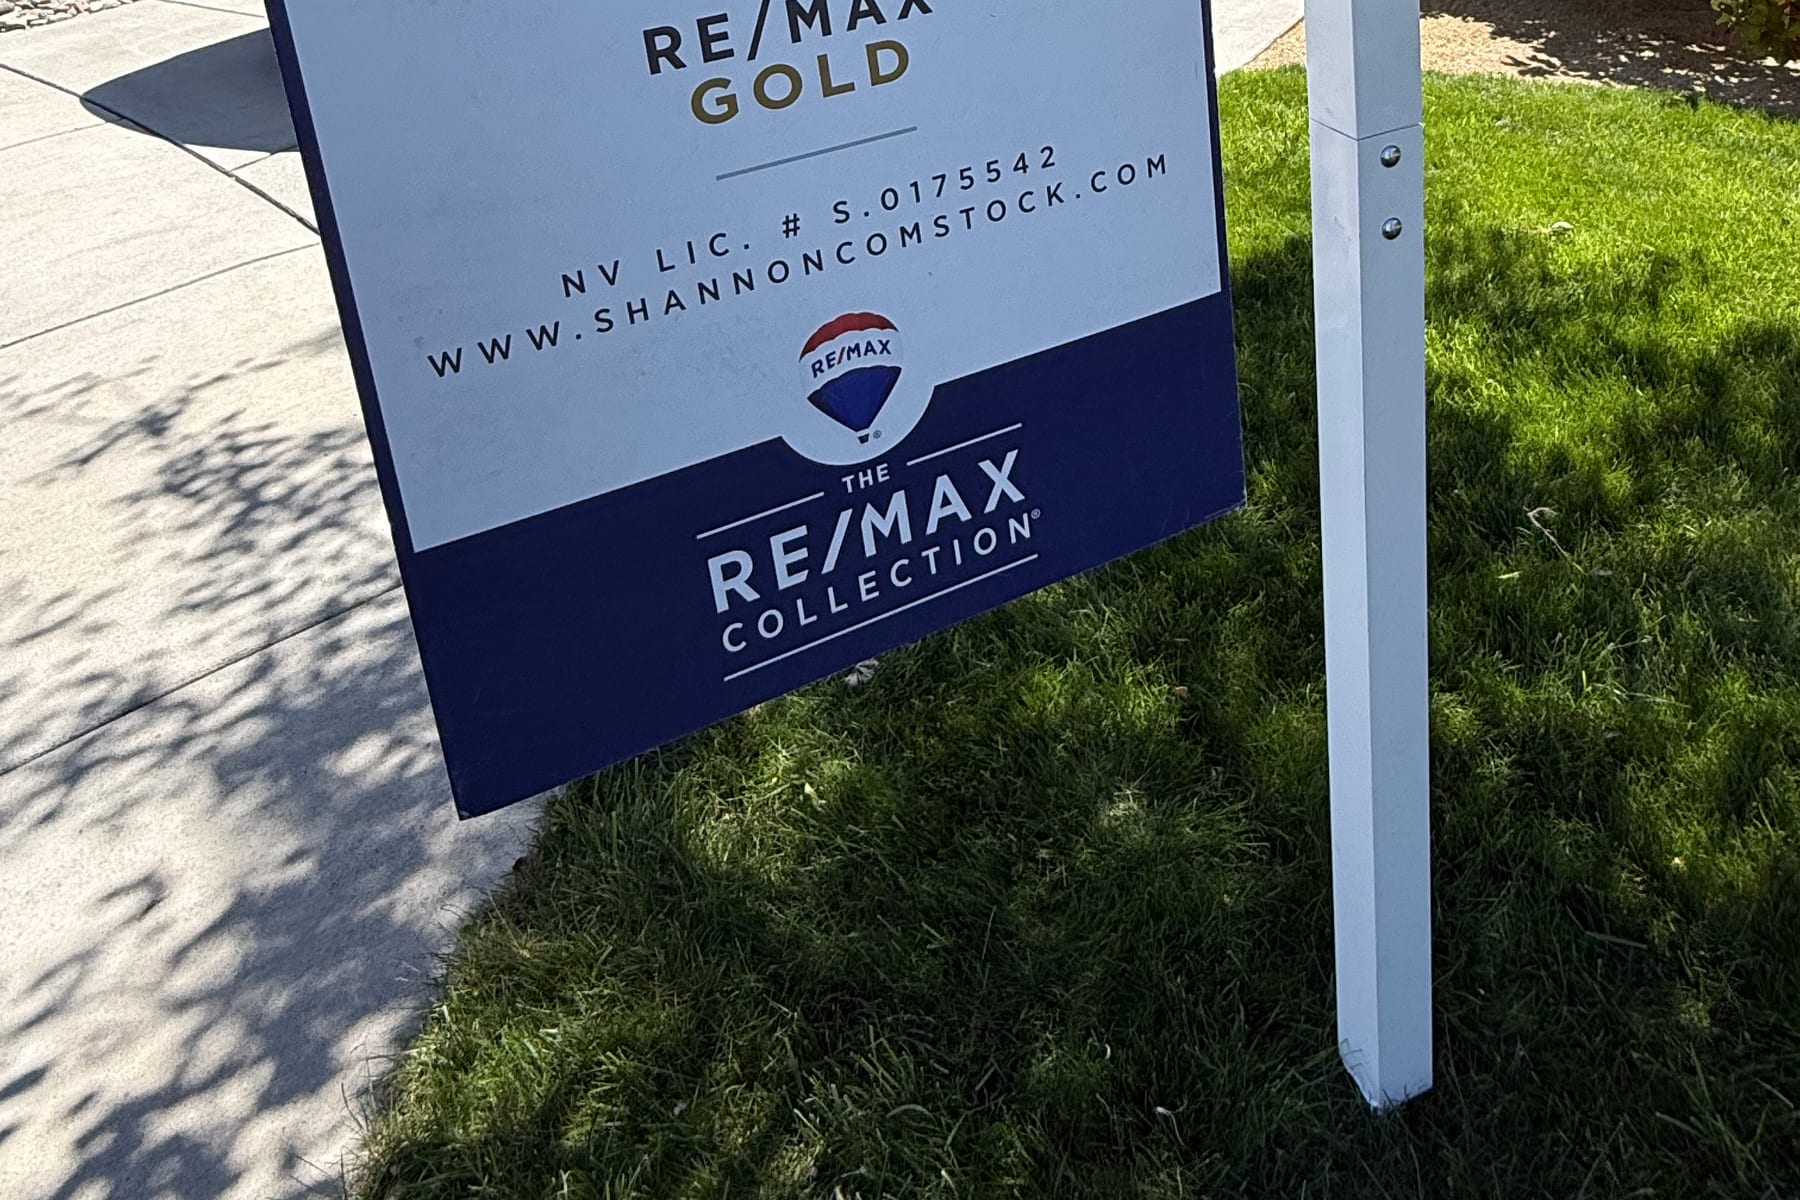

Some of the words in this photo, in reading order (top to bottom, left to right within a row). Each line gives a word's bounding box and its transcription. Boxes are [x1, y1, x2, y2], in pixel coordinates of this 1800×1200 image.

[690, 39, 910, 124] GOLD
[427, 154, 1168, 378] WWW.SHANNONCOMSTOCK.COM
[562, 259, 622, 298] NV
[656, 232, 751, 273] LIC.
[782, 213, 802, 239] #
[833, 145, 1058, 225] S.0175542
[810, 338, 892, 379] RE/MAX
[706, 449, 1027, 613] RE/MAX
[842, 464, 890, 494] THE
